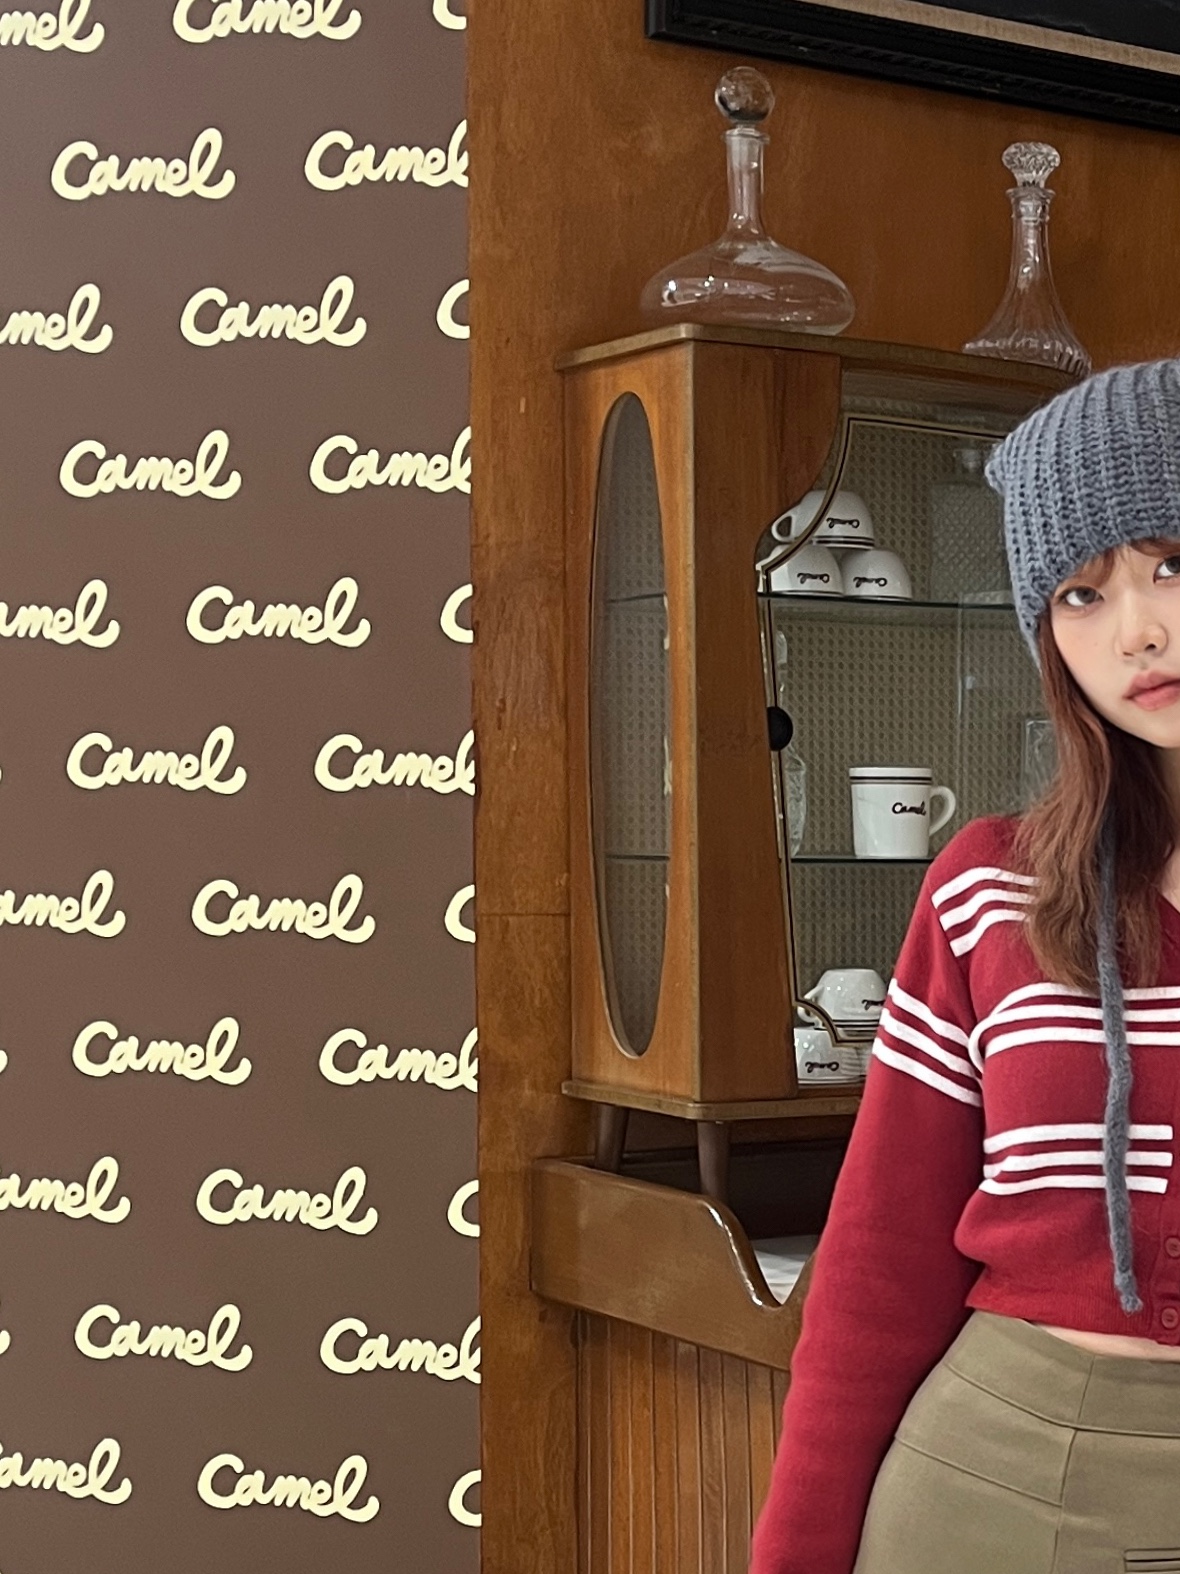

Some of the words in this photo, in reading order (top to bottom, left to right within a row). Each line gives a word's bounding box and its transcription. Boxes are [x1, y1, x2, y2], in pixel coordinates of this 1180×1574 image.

[0, 0, 104, 53] mel
[51, 128, 235, 200] Camel
[0, 284, 113, 353] mel
[181, 276, 366, 346] Camel
[60, 430, 241, 499] Camel
[187, 577, 370, 647] Camel
[67, 726, 246, 794] Camel
[892, 801, 927, 816] Camel
[0, 870, 125, 937] amel
[192, 874, 375, 943] Camel
[73, 1017, 251, 1085] Camel
[0, 1157, 130, 1223] amel
[197, 1167, 377, 1234] Camel
[75, 1304, 252, 1371] Camel
[0, 1438, 132, 1504] amel
[198, 1454, 379, 1522] Camel
